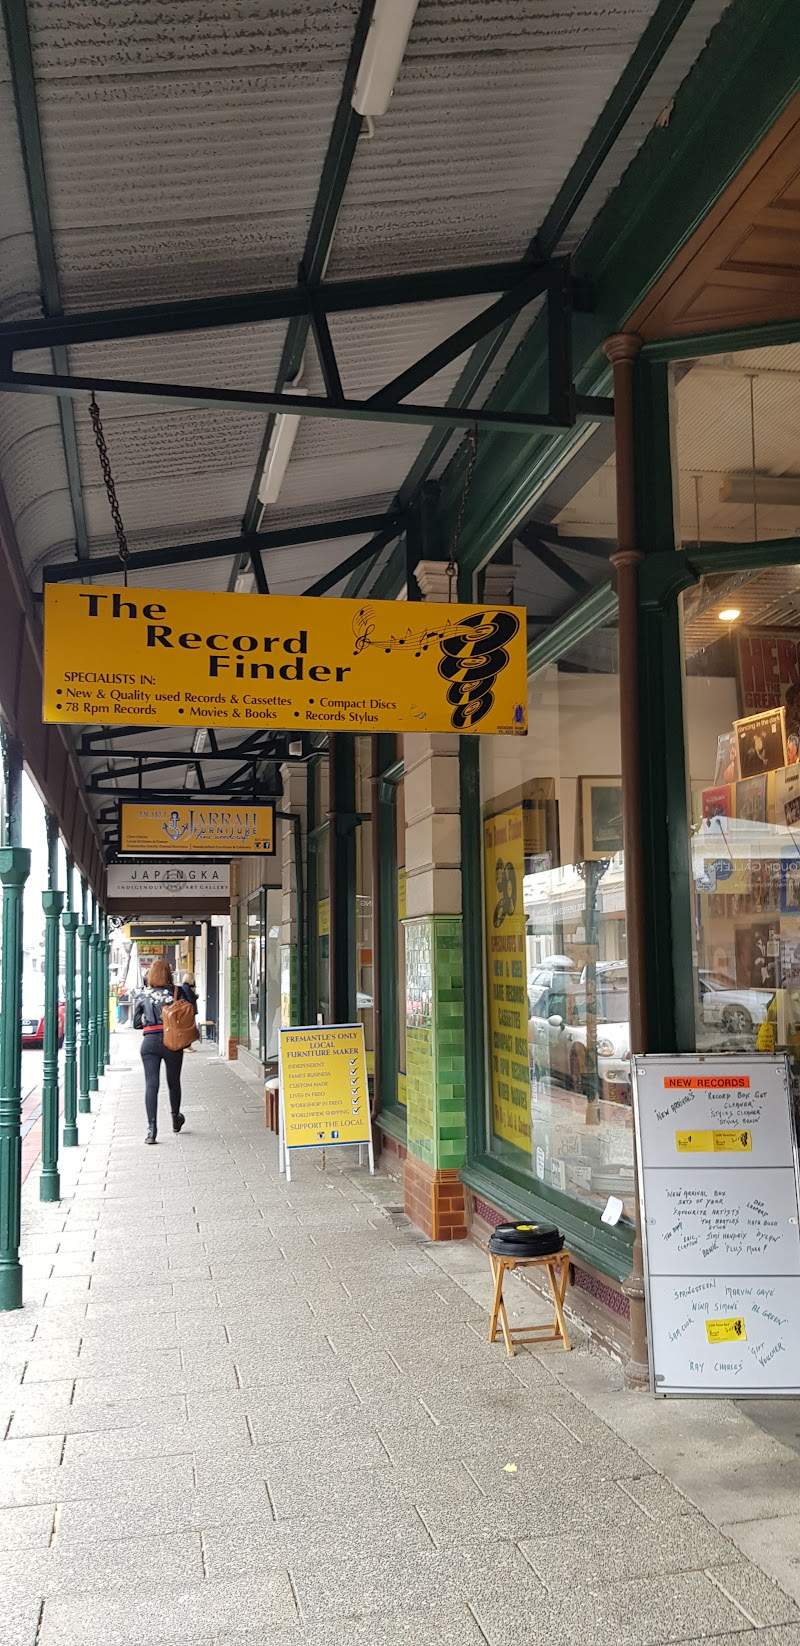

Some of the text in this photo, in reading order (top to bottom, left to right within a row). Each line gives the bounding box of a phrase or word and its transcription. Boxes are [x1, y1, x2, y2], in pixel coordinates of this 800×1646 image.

[79, 593, 167, 621] The
[146, 624, 308, 654] Record
[209, 655, 351, 682] Finder
[64, 671, 156, 685] SPECIALISTS IN:
[66, 688, 292, 706] New & Quality used Records & Cassettes
[65, 702, 157, 716] 78 Rpm Records
[320, 698, 397, 710] Compact Discs
[189, 707, 277, 719] Movies & Books
[305, 711, 379, 724] Records Stylus
[189, 809, 256, 832] JARRAH
[131, 870, 219, 880] JAPINGKA
[337, 1032, 358, 1040] ONLY
[310, 1041, 335, 1049] LOCAL
[287, 1047, 359, 1058] FURNITURE MAKER
[670, 1078, 745, 1088] NEW RECORDS
[290, 1119, 365, 1130] SUPPORT THE LOCAL
